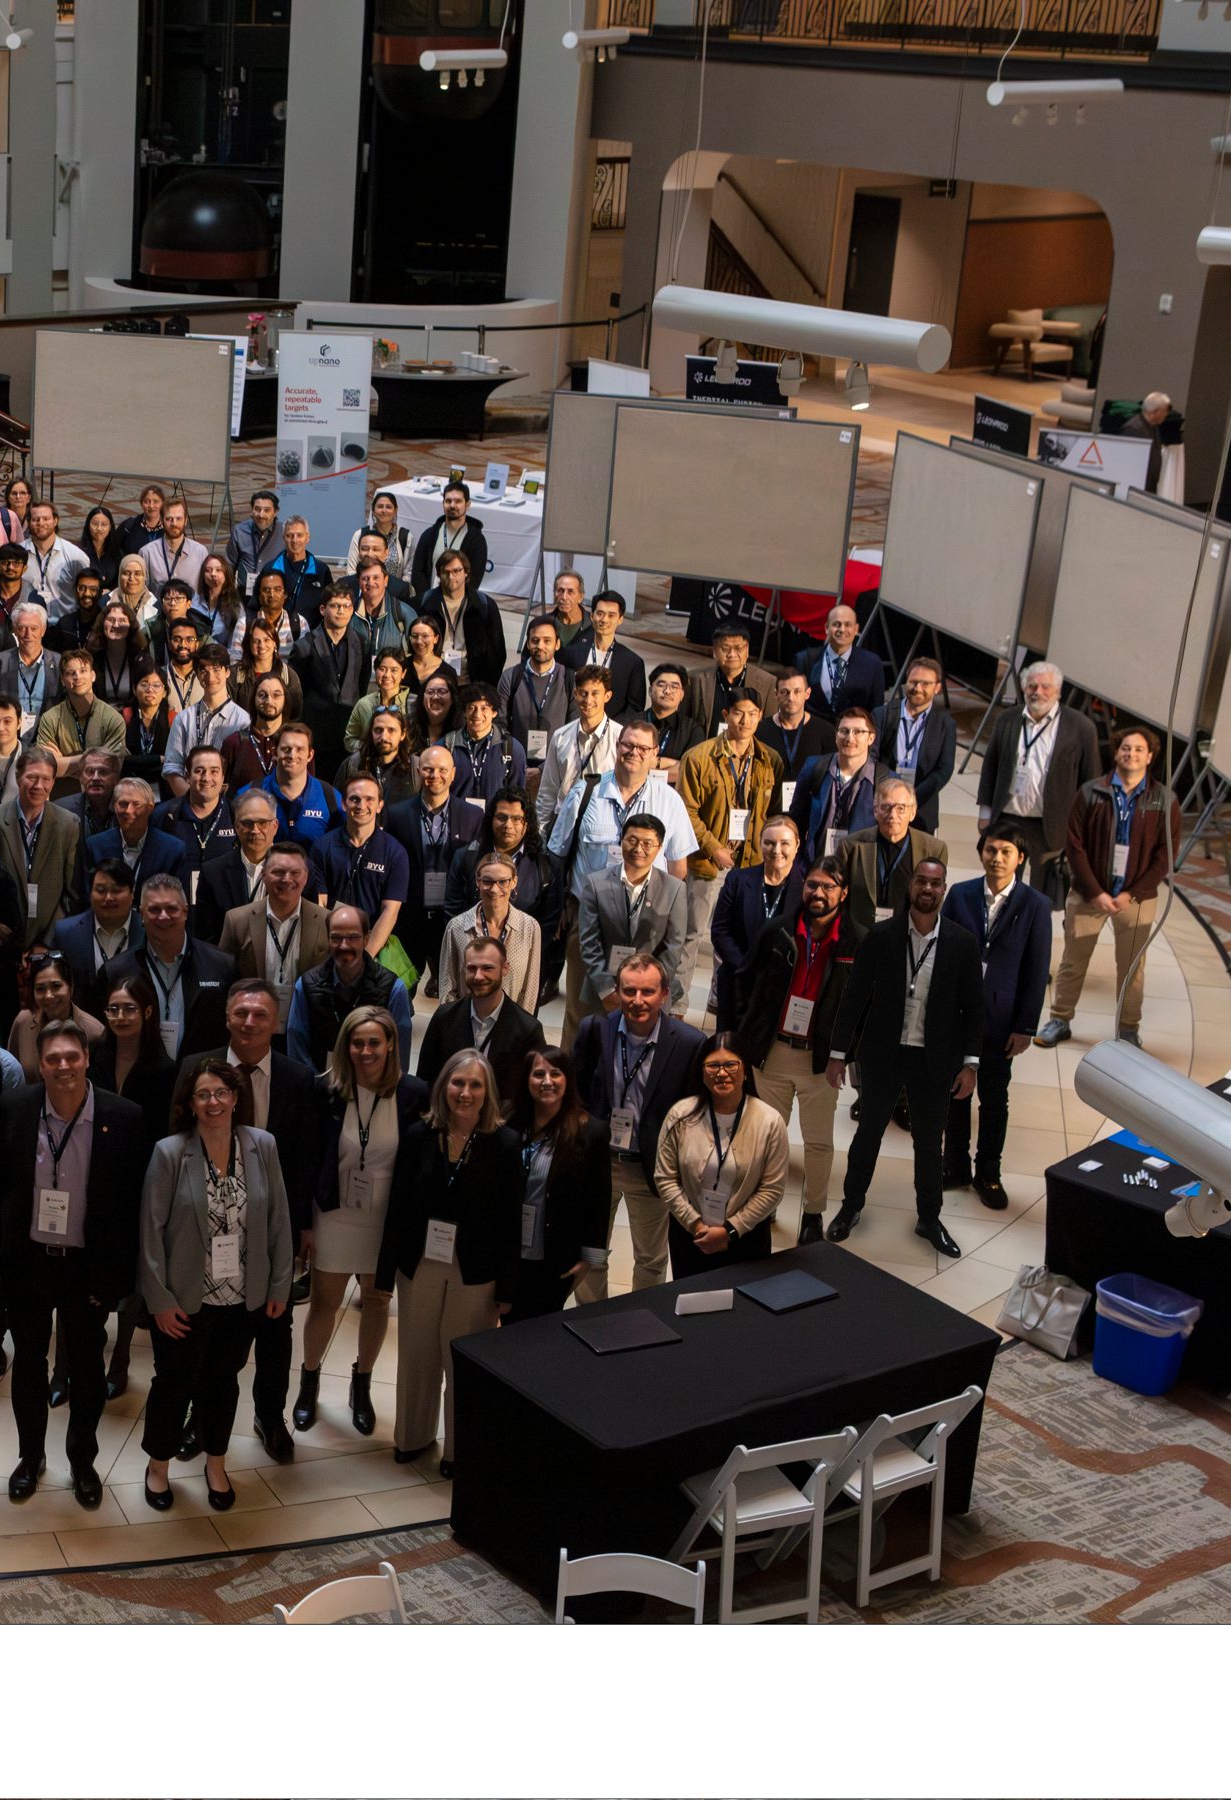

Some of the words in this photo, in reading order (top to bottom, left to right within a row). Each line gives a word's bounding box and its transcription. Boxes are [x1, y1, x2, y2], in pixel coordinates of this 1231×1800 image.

[284, 387, 318, 395] Accurate,
[284, 396, 322, 405] repeatable
[284, 404, 309, 412] targets
[303, 809, 323, 818] BYU
[366, 861, 385, 871] BYU
